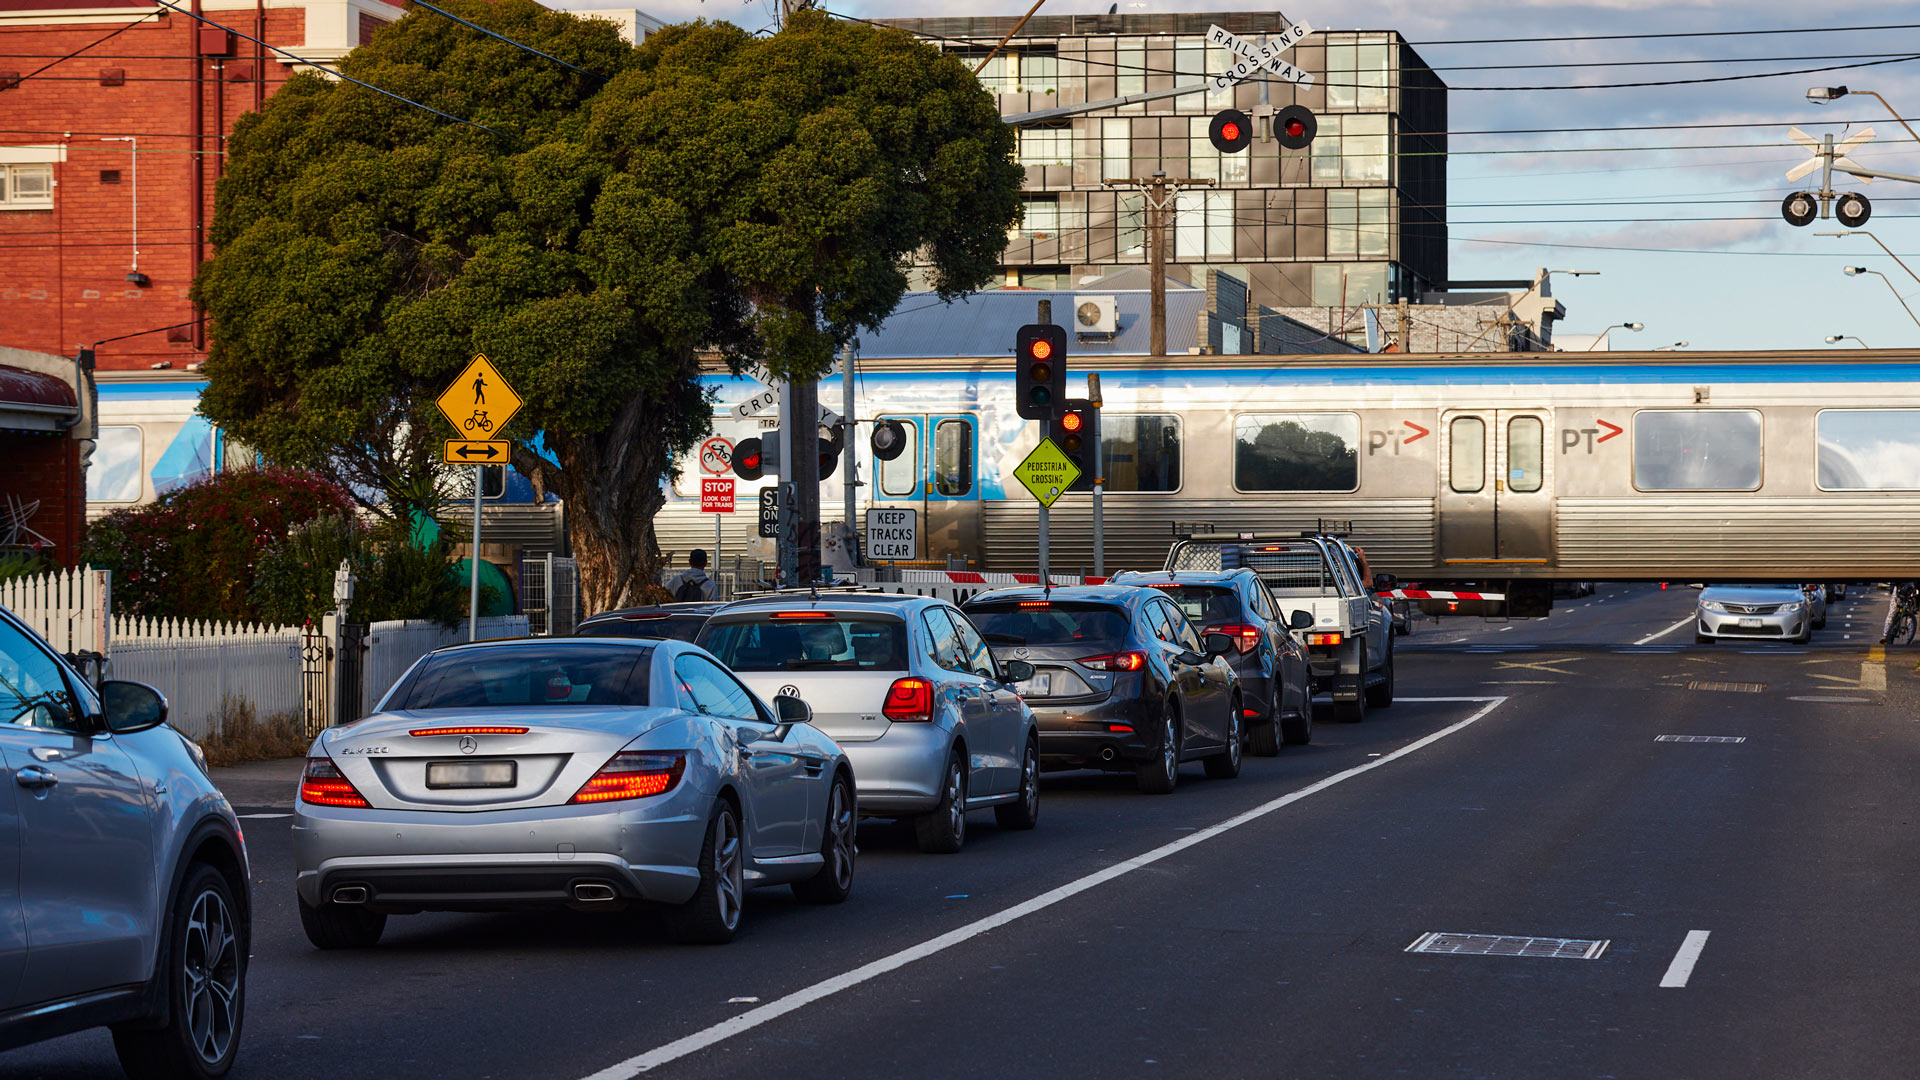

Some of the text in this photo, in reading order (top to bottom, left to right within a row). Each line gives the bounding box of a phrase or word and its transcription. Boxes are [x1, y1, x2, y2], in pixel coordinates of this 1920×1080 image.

[1216, 25, 1304, 89] CROSSING
[1027, 462, 1067, 472] PEDESTRIAN
[1031, 474, 1063, 484] CROSSING
[704, 482, 732, 493] STOP
[763, 510, 778, 521] ON
[877, 512, 906, 525] KEEP
[870, 528, 913, 541] TRACKS
[873, 544, 909, 556] CLEAR
